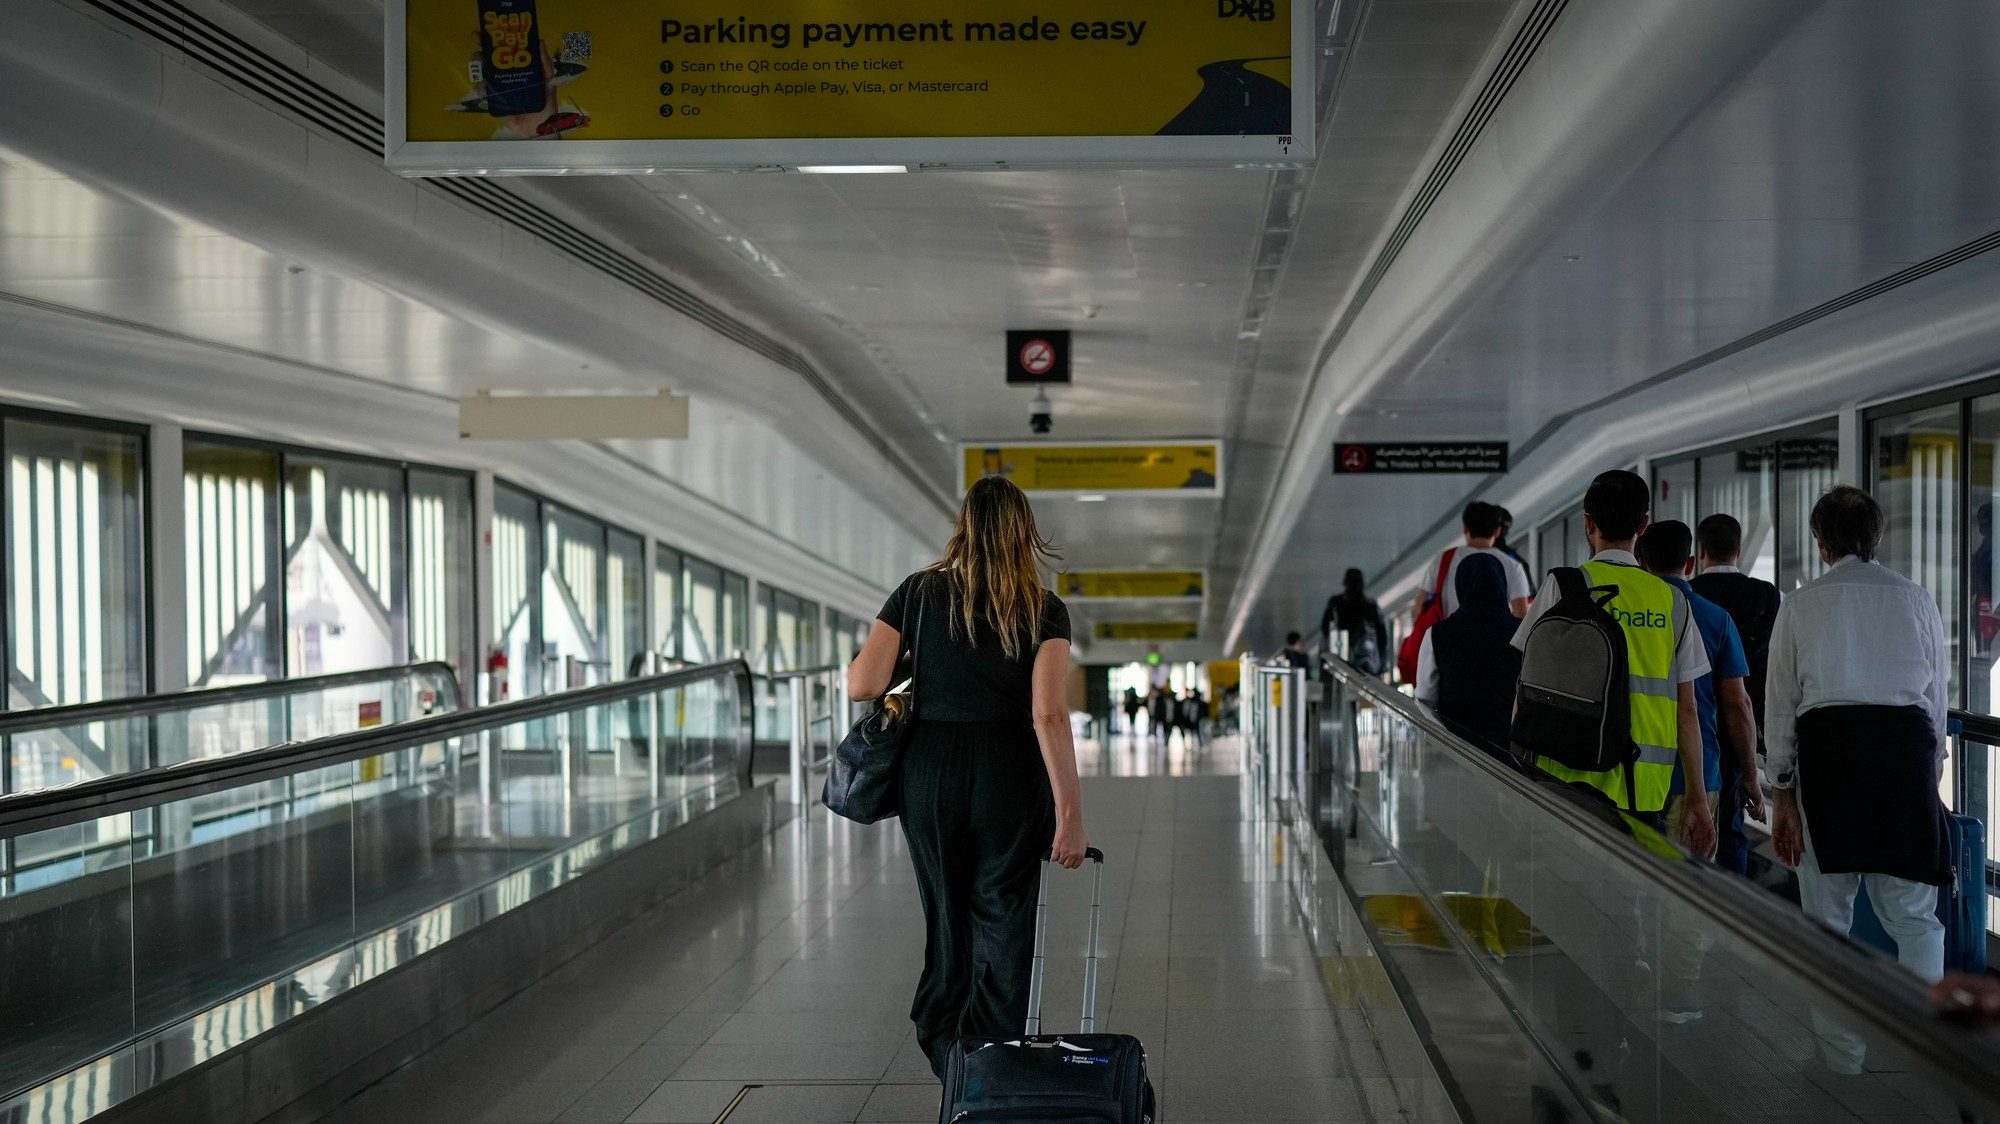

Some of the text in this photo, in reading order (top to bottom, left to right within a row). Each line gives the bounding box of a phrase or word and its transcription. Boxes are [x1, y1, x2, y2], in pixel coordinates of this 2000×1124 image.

[484, 11, 532, 30] Scan
[492, 29, 528, 49] Pay
[661, 16, 1146, 48] Parking payment made easy
[681, 60, 715, 71] Scan
[720, 60, 743, 71] the
[748, 60, 769, 73] QR
[774, 59, 808, 71] code
[812, 62, 830, 70] on
[836, 59, 859, 70] the
[863, 59, 904, 70] ticket
[682, 83, 707, 96] Pay
[711, 82, 770, 96] through
[774, 82, 816, 96] Apple
[820, 82, 849, 95] Pay,
[853, 81, 885, 94] Visa,
[889, 83, 904, 93] or
[908, 80, 988, 92] Mastercard
[680, 104, 700, 116] Go
[1278, 136, 1292, 144] PPB
[1282, 146, 1288, 154] 1
